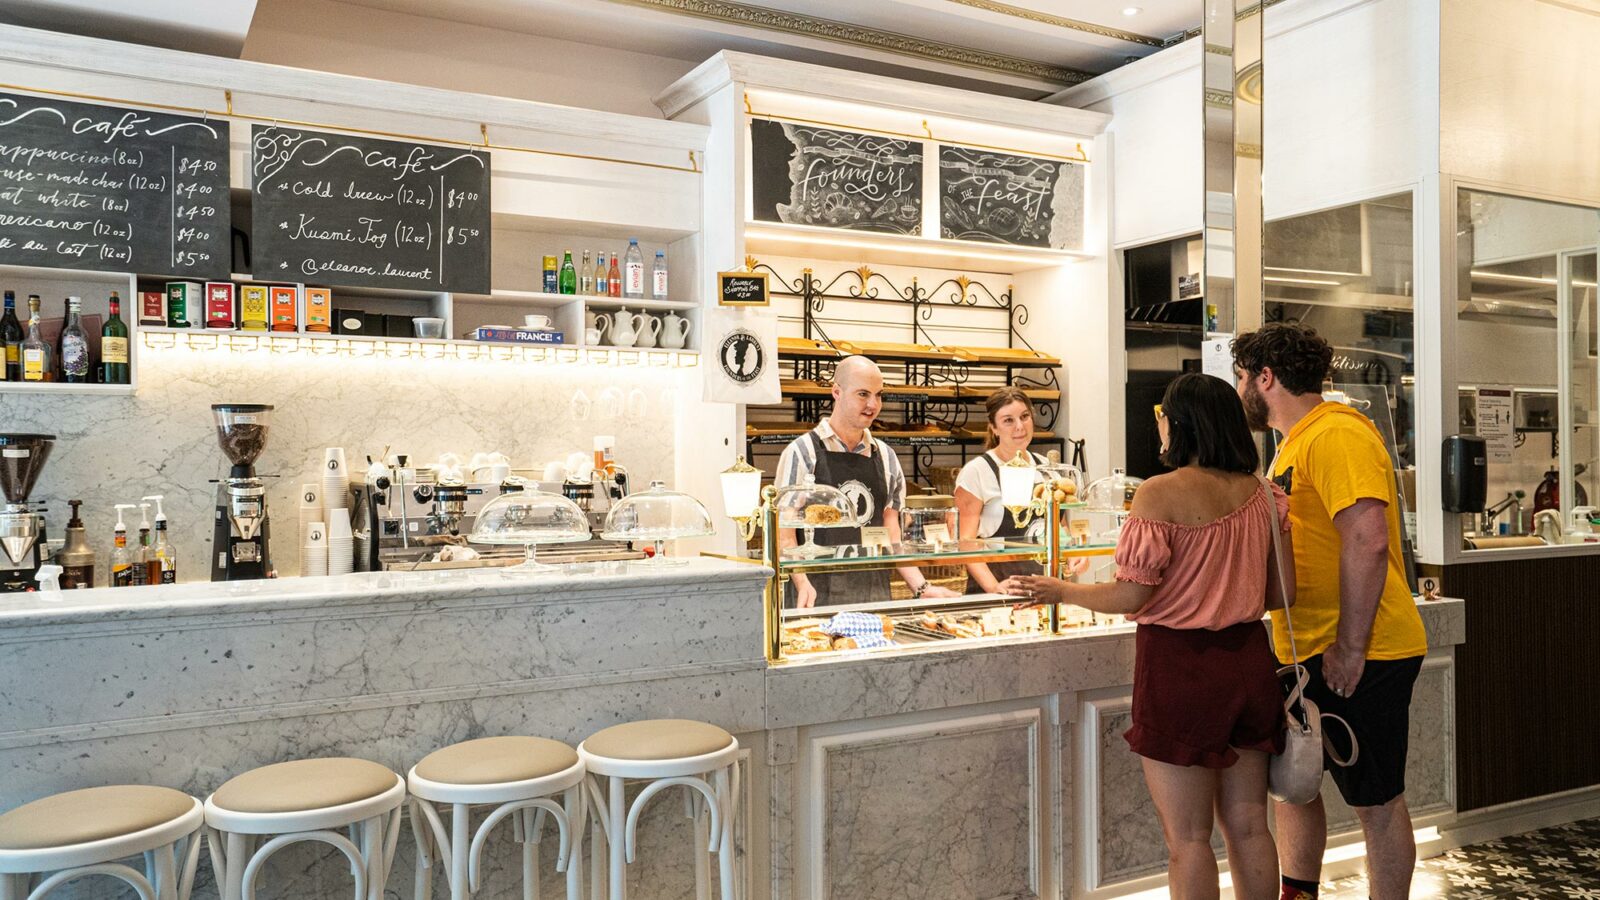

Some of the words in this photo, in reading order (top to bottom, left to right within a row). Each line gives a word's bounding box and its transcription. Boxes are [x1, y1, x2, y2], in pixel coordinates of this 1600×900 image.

[72, 112, 151, 143] café
[0, 143, 113, 167] appuccino
[364, 147, 435, 181] café
[92, 171, 124, 189] chai
[38, 189, 97, 208] white
[290, 213, 356, 243] Kusmi
[358, 217, 388, 249] Fog
[632, 269, 640, 289] evian
[516, 331, 553, 342] FRANCE!
